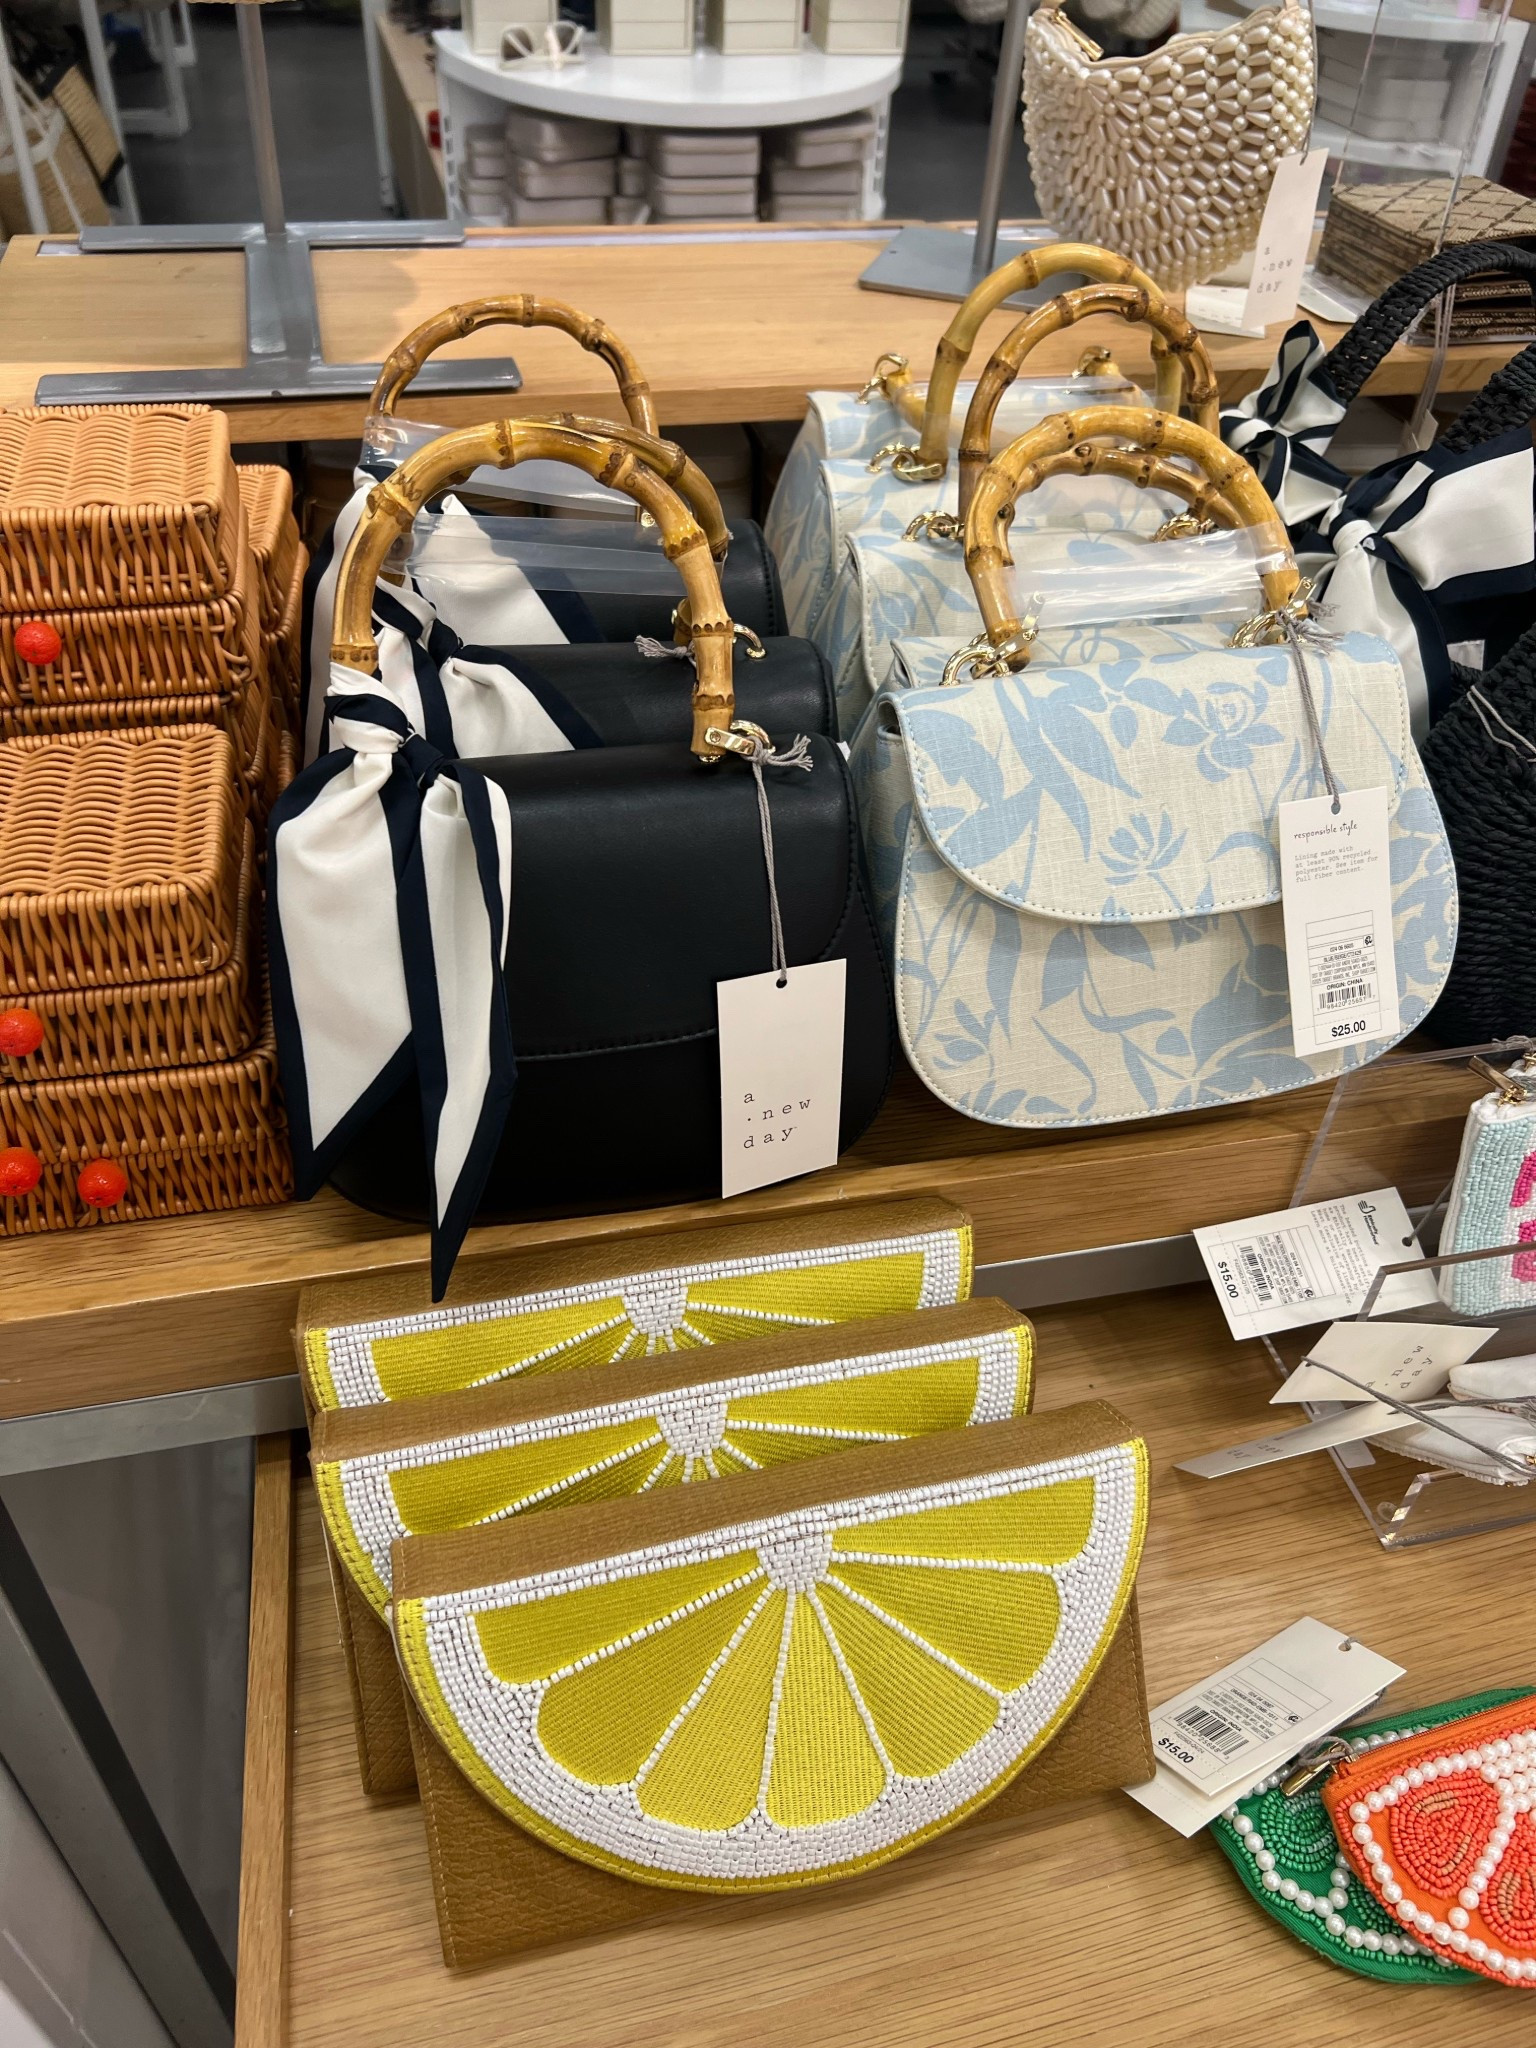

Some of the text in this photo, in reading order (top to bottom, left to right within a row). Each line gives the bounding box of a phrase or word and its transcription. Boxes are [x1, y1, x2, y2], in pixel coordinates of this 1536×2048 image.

[1294, 820, 1357, 843] responsible style
[1295, 852, 1318, 861] Lining
[1343, 849, 1371, 860] recycled
[1347, 978, 1362, 987] CHINA
[1331, 1020, 1366, 1037] $25.00
[744, 1093, 755, 1104] a
[743, 1127, 793, 1149] day
[1218, 1262, 1238, 1298] $15.00
[1400, 1356, 1433, 1389] day
[1228, 1722, 1242, 1731] INDIA
[1158, 1738, 1194, 1763] $15.00
